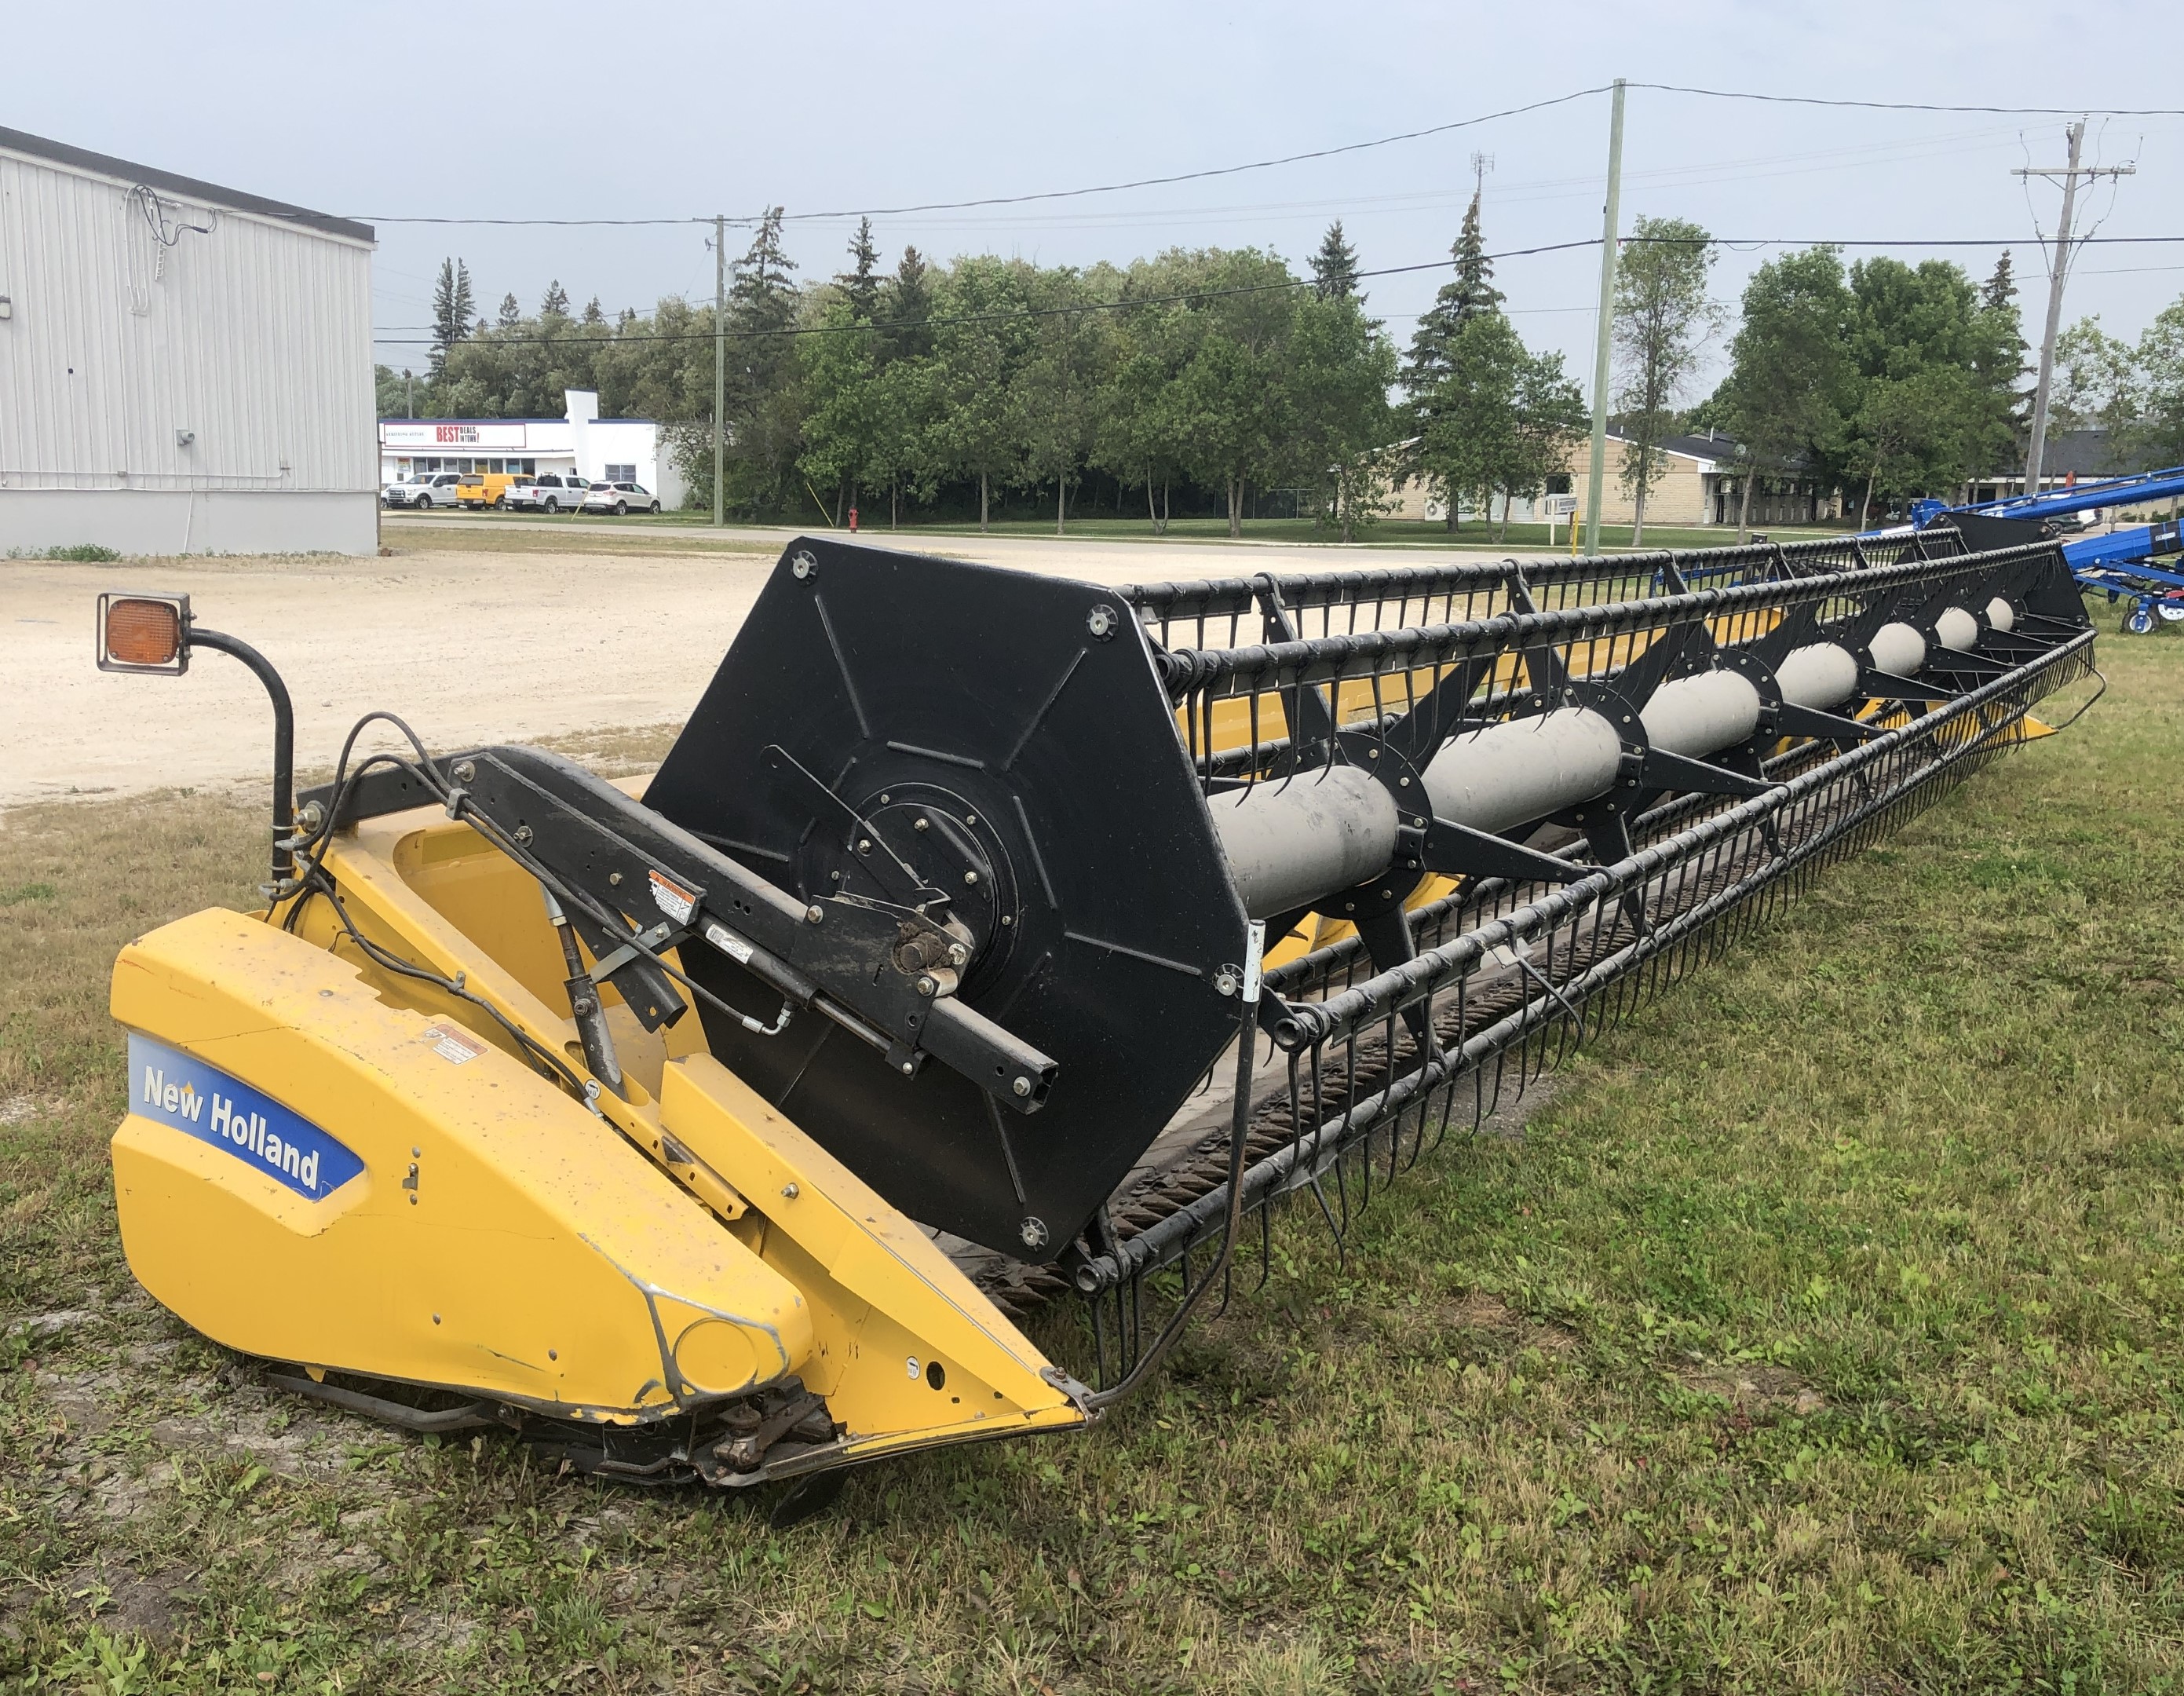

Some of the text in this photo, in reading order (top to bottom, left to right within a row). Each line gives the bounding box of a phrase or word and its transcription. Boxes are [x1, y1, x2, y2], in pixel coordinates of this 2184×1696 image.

[436, 426, 459, 442] BEST
[144, 1065, 320, 1190] New Holland
